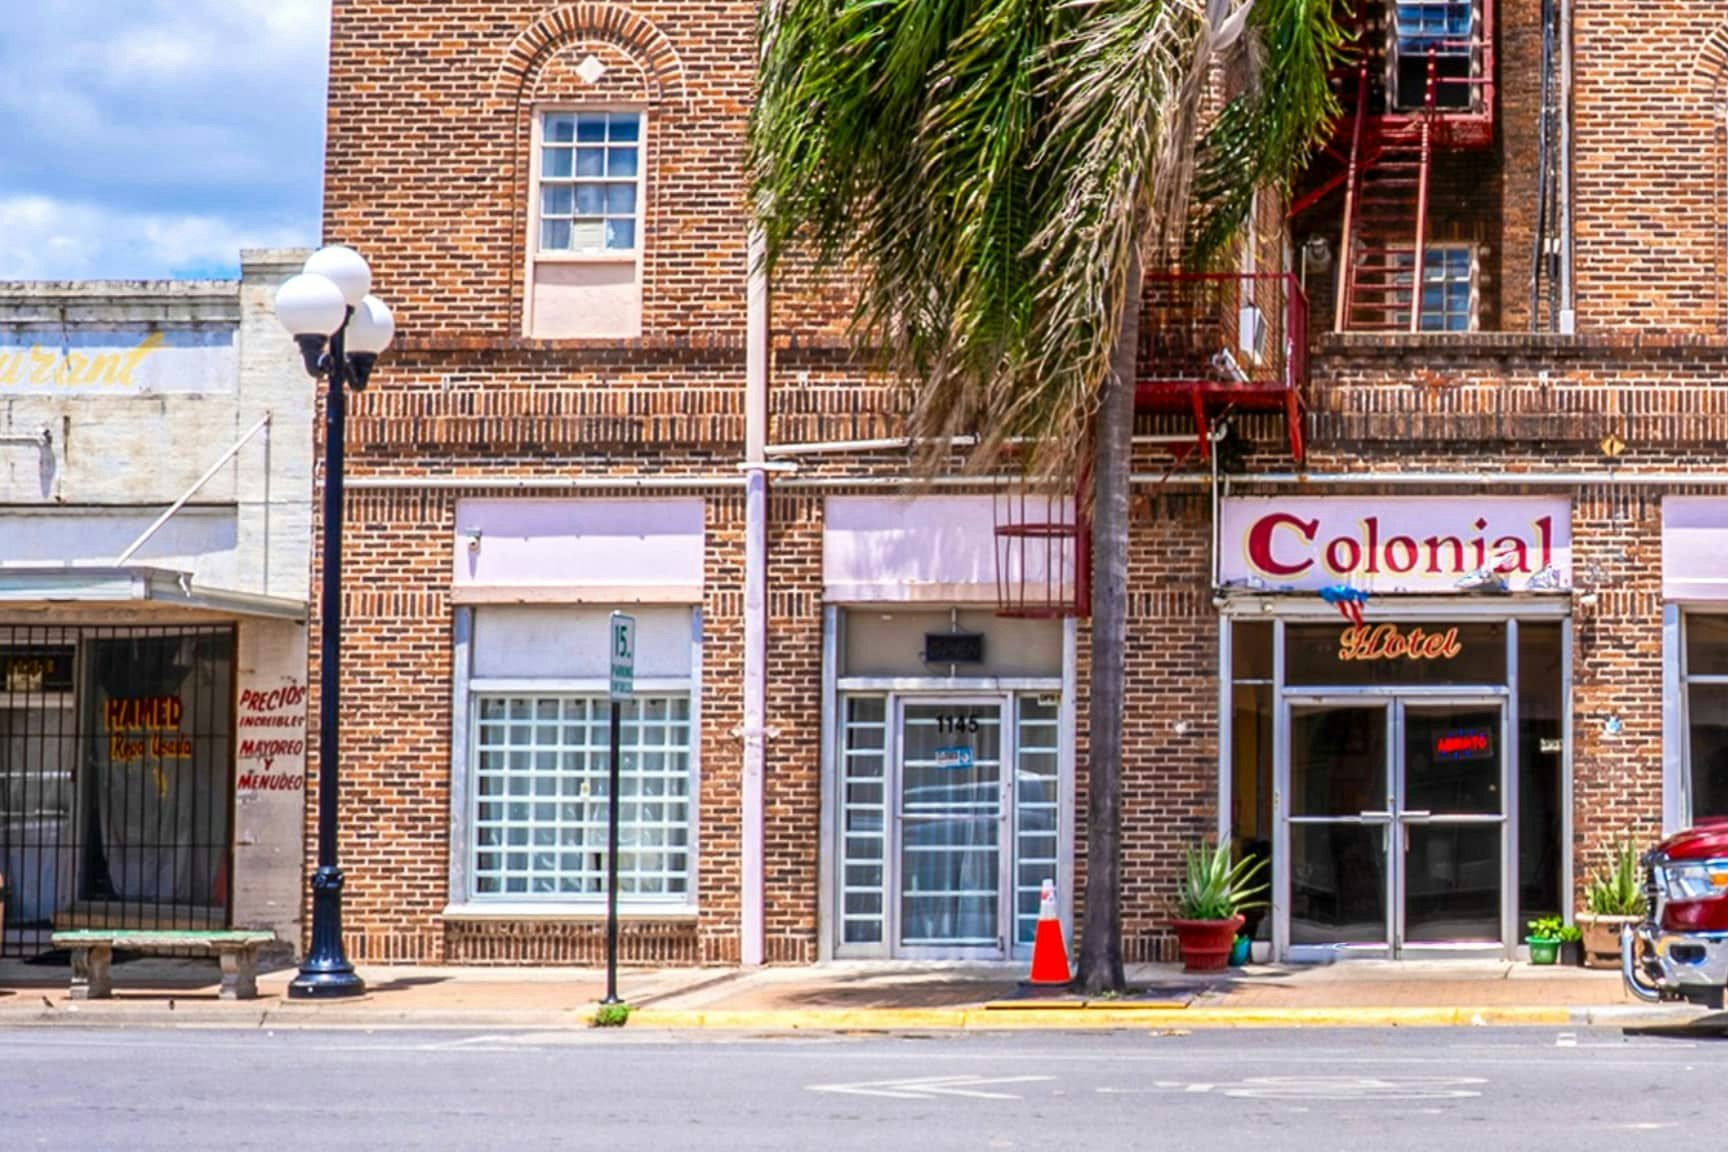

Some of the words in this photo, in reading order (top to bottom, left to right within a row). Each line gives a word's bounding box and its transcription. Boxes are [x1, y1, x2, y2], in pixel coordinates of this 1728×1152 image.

[1246, 511, 1555, 577] Colonial
[1338, 622, 1463, 662] Hotel
[240, 685, 306, 712] PRECIOS
[936, 715, 980, 734] 1145
[239, 739, 304, 756] MAYOREO
[263, 758, 274, 771] Y
[238, 774, 304, 790] MENUDEO
